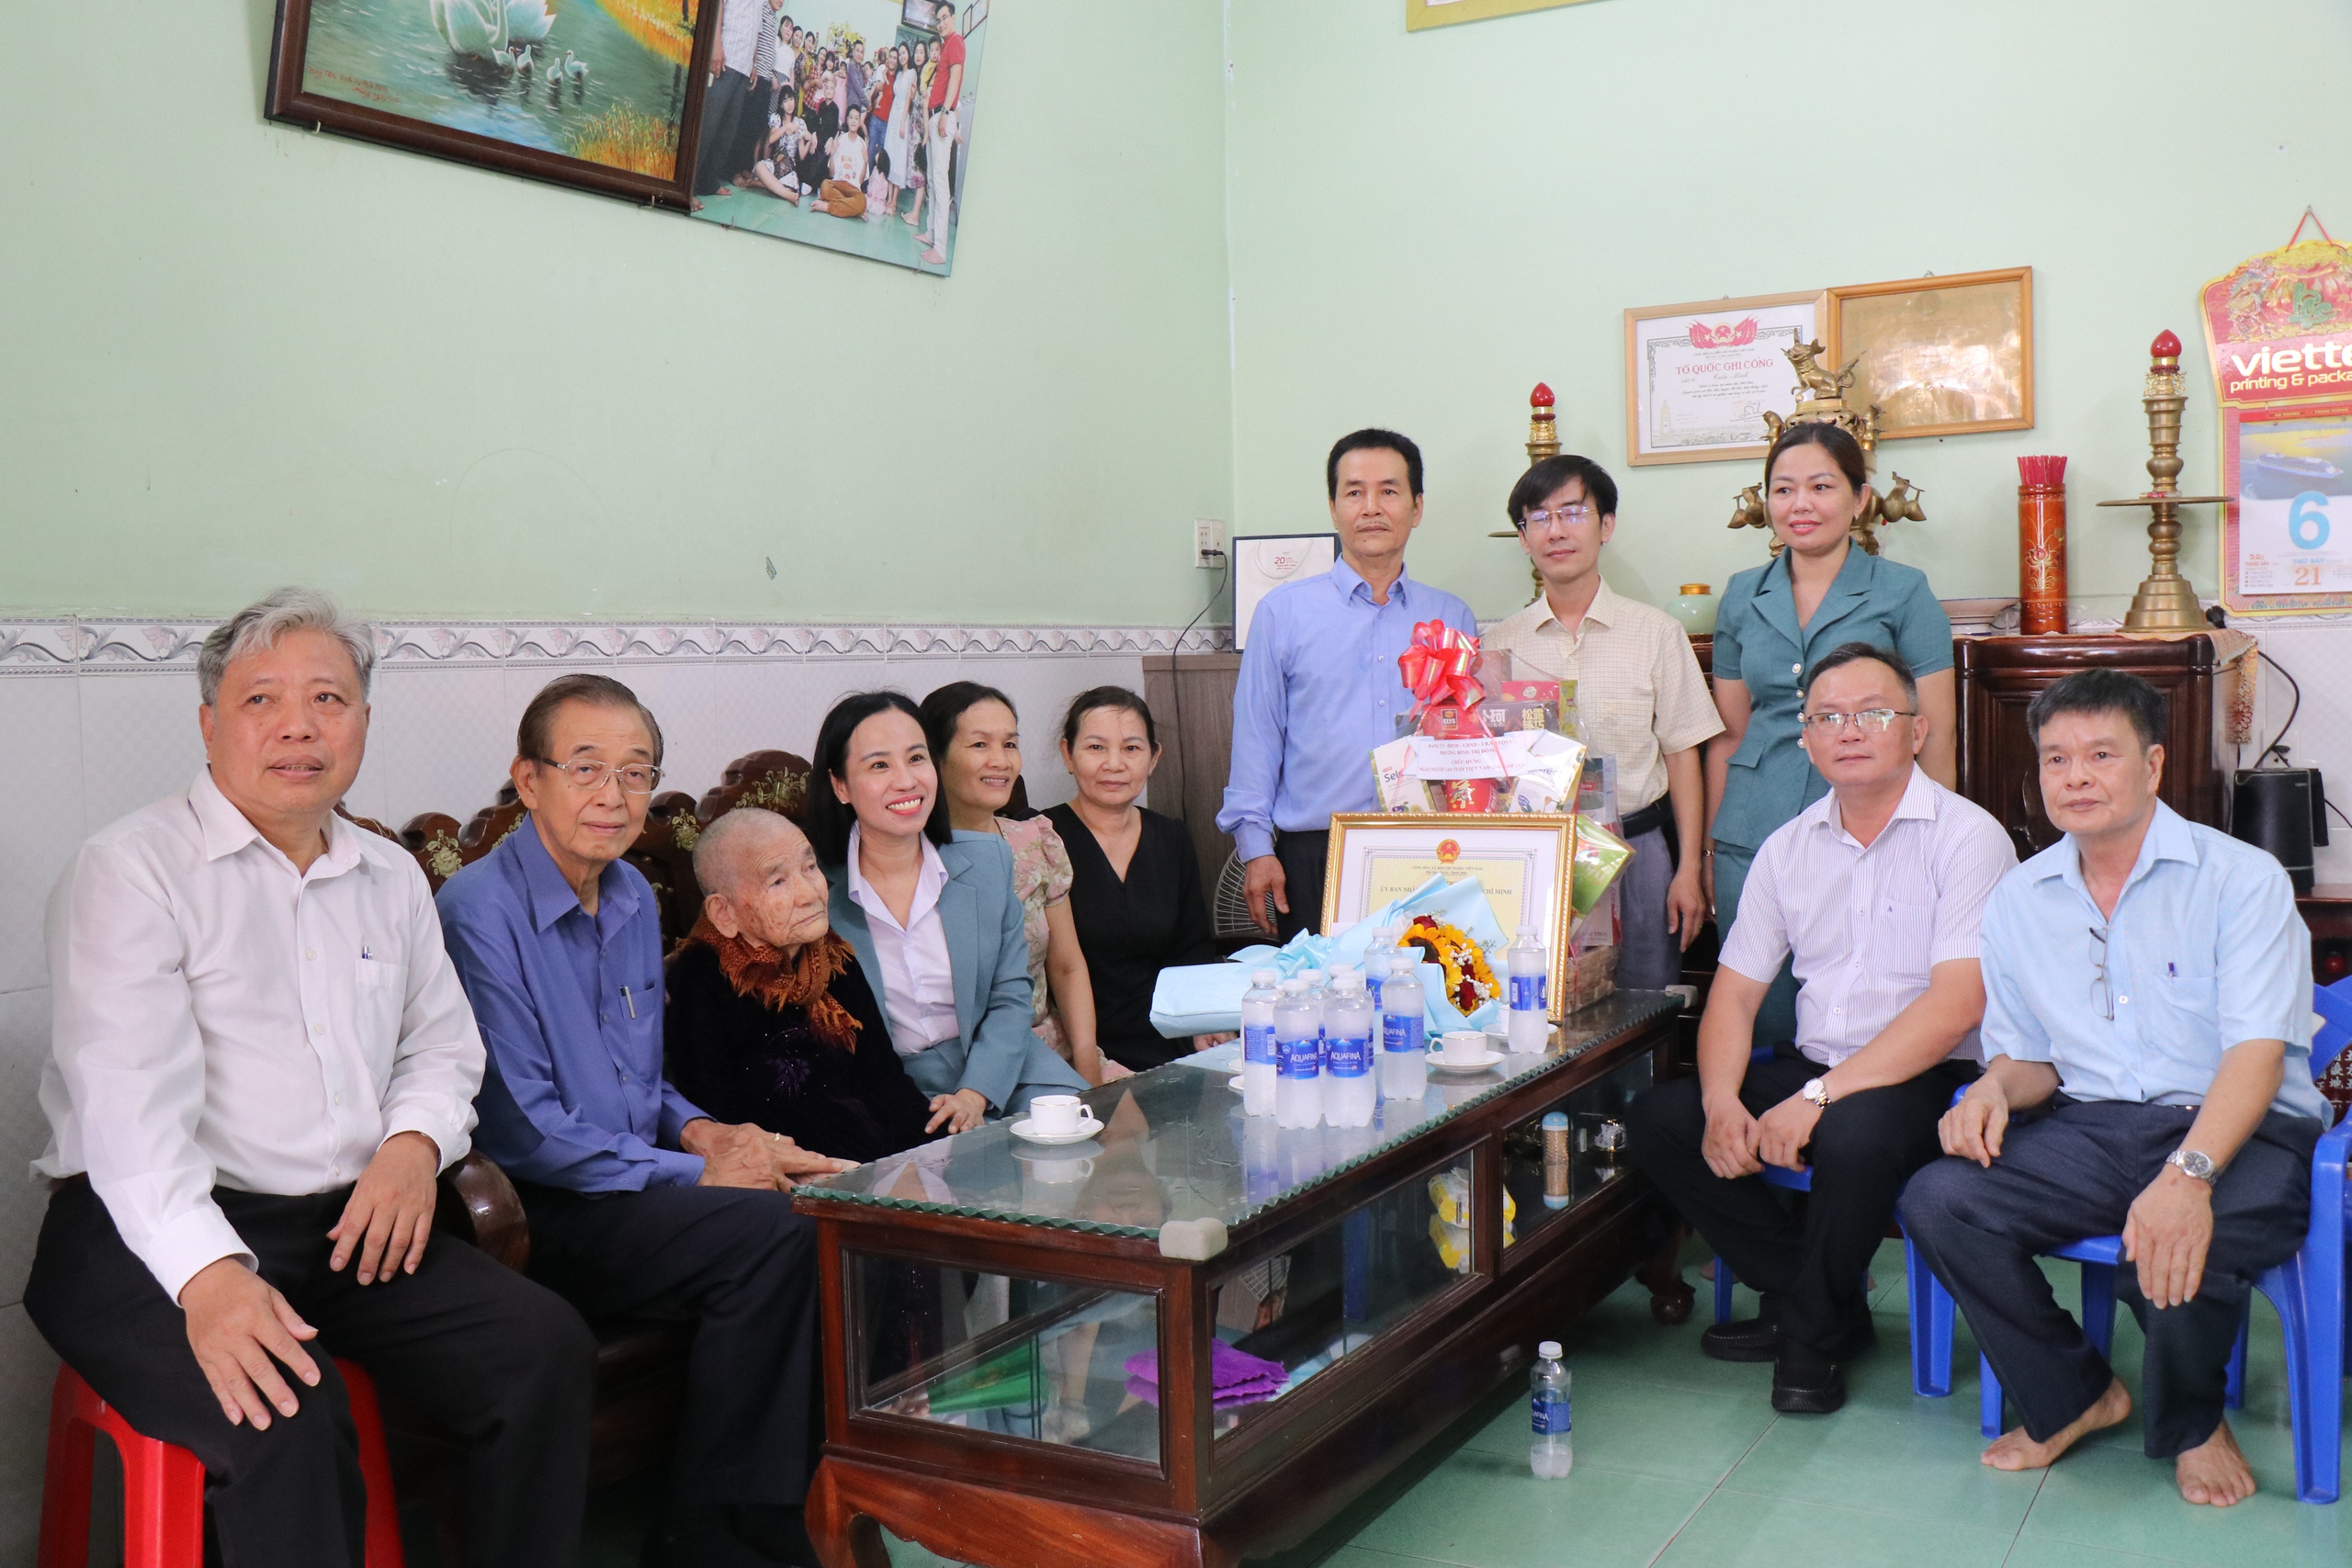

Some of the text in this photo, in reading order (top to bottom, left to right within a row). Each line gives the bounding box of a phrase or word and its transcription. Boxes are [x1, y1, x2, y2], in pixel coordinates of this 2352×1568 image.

[1676, 364, 1690, 375] TỔ
[1692, 361, 1722, 375] QUỐC
[1724, 362, 1742, 370] GHI
[2231, 376, 2288, 393] printing
[2291, 373, 2304, 386] &
[2289, 491, 2330, 550] 6
[2294, 566, 2322, 586] 21
[1330, 1051, 1362, 1061] AQUAFINA
